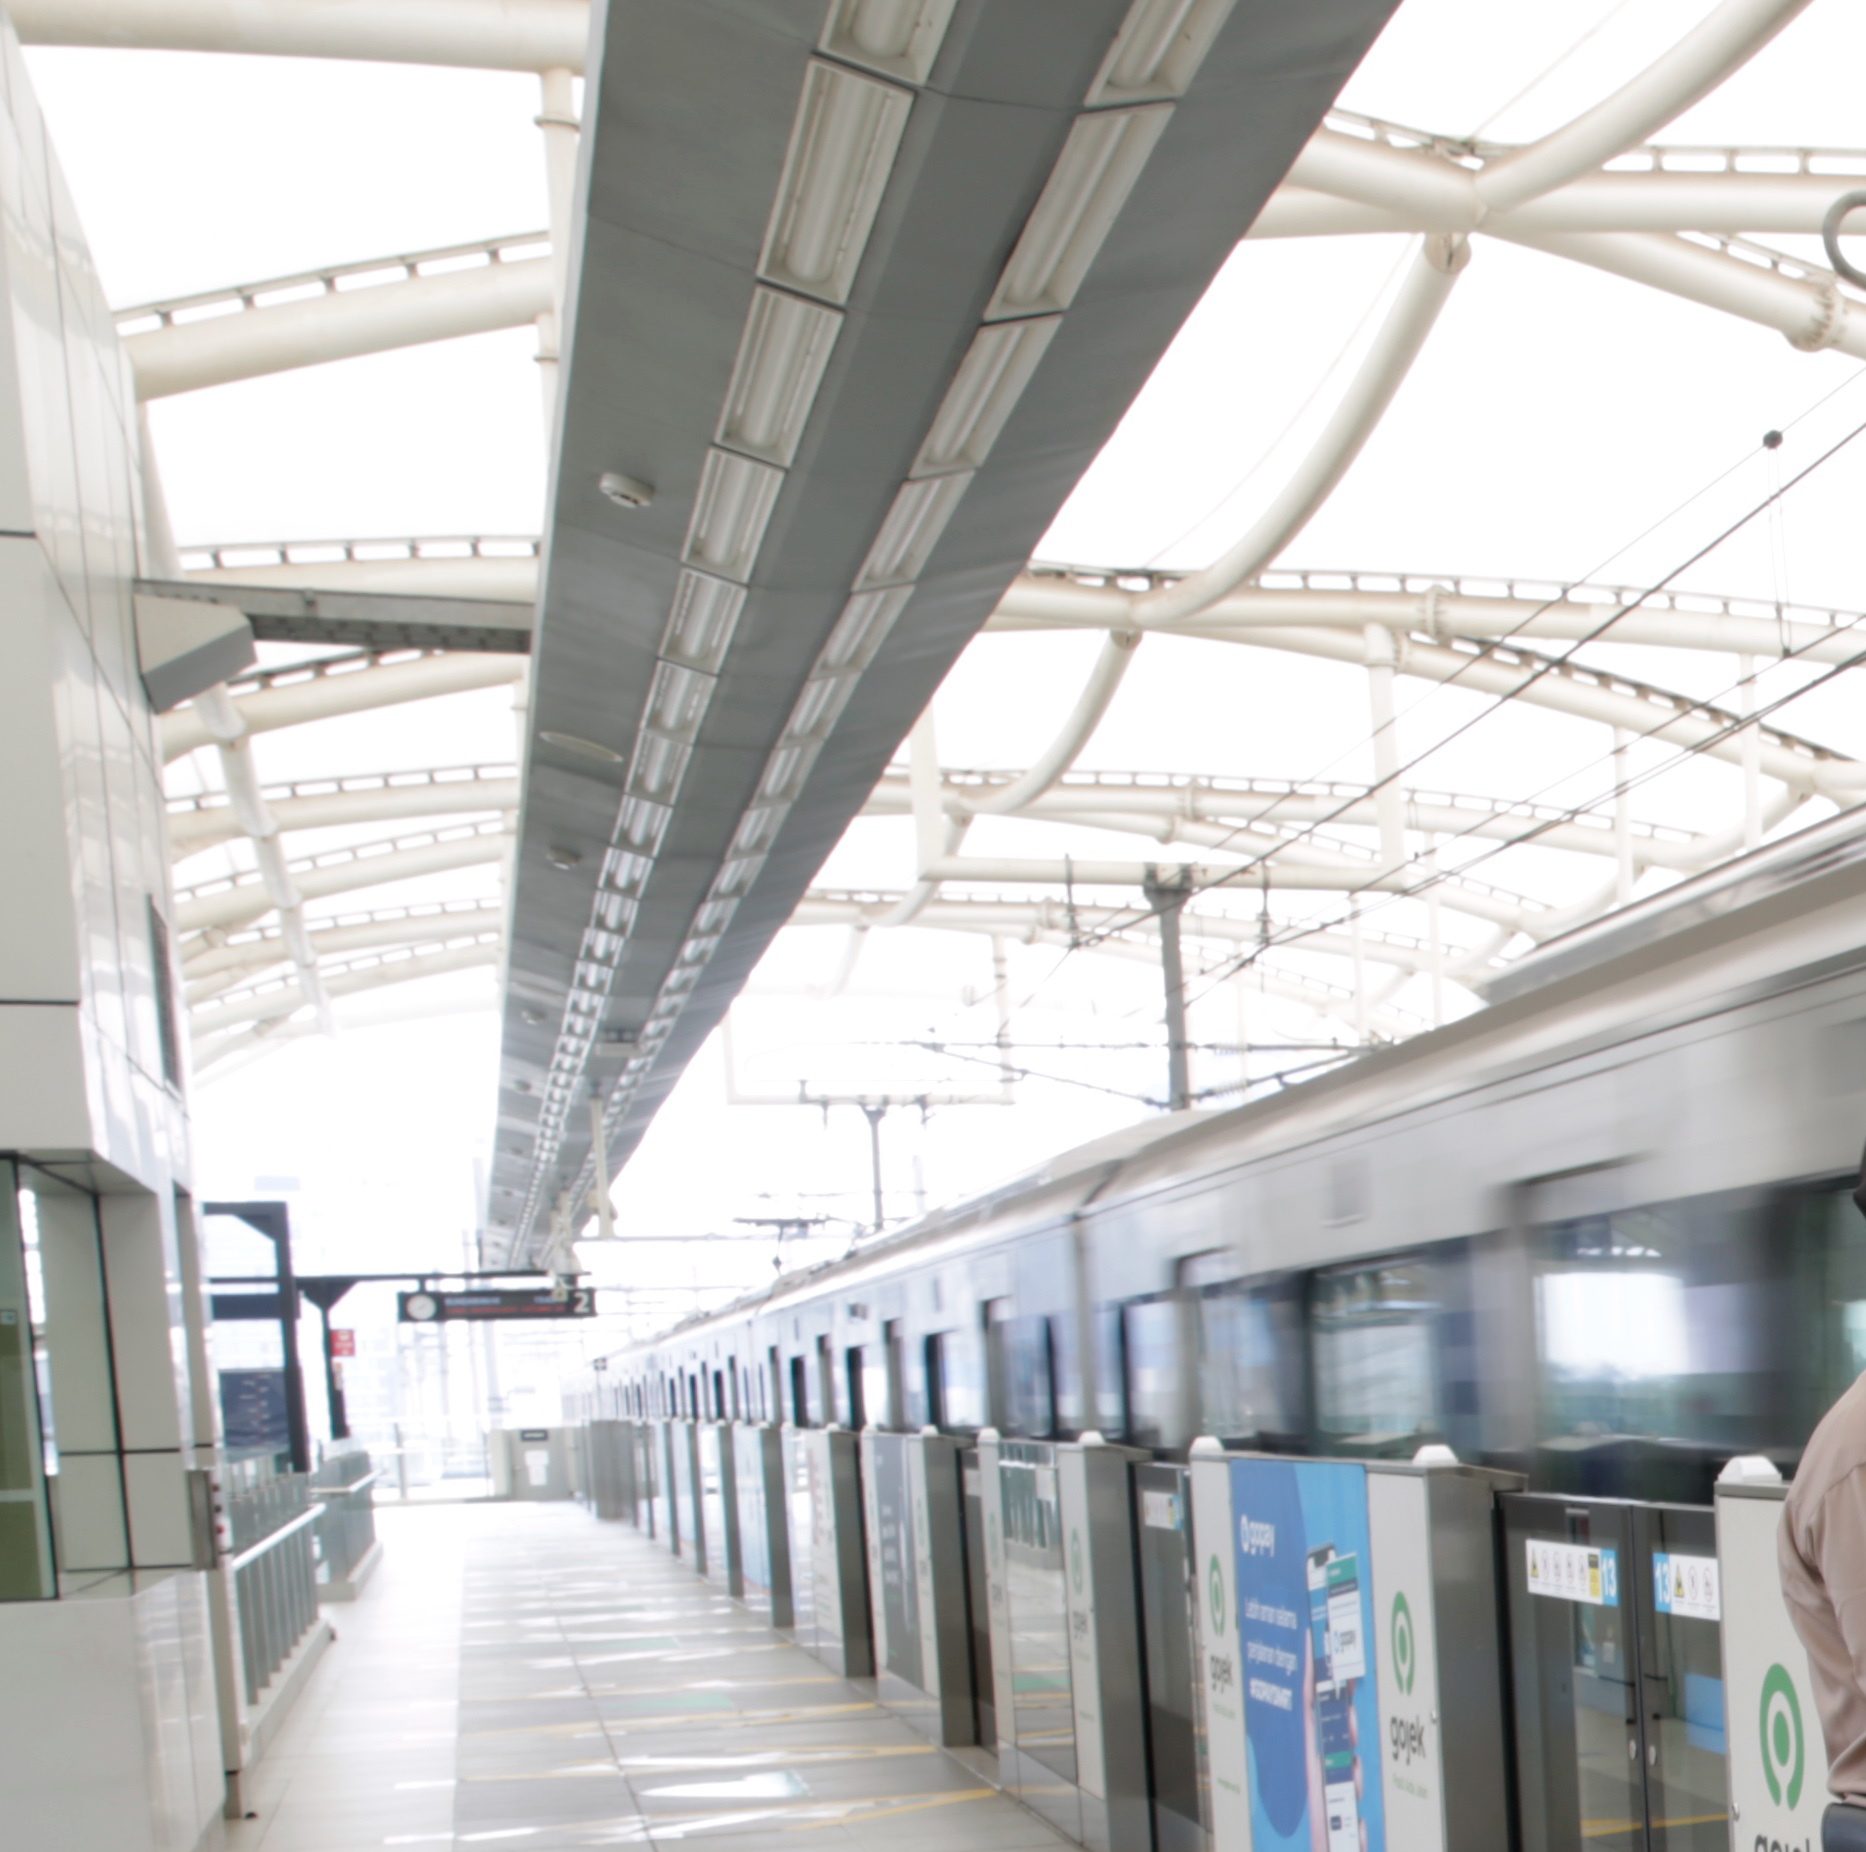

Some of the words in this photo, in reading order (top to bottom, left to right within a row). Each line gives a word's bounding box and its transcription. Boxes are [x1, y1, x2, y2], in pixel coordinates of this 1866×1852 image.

[573, 1291, 589, 1313] 2
[1601, 1557, 1617, 1598] 13
[1654, 1562, 1670, 1604] 13
[1390, 1714, 1426, 1766] gojek
